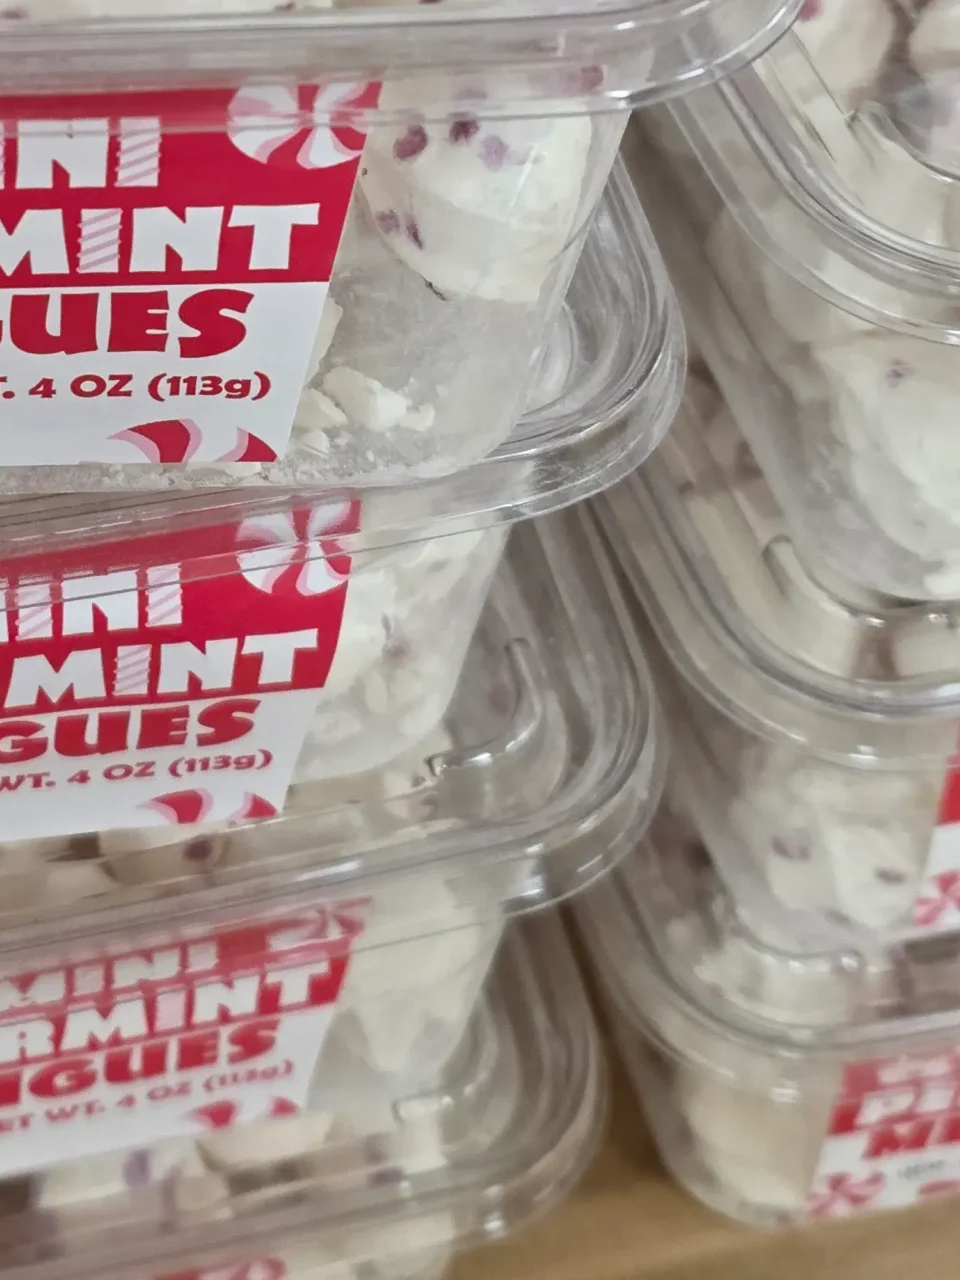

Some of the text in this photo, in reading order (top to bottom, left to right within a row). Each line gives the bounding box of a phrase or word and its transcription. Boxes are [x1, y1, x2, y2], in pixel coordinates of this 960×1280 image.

[27, 376, 57, 400] 4
[69, 373, 135, 400] OZ
[146, 370, 272, 403] (113g)
[67, 768, 91, 786] 4
[102, 759, 157, 782] OZ
[166, 748, 274, 779] (113g)
